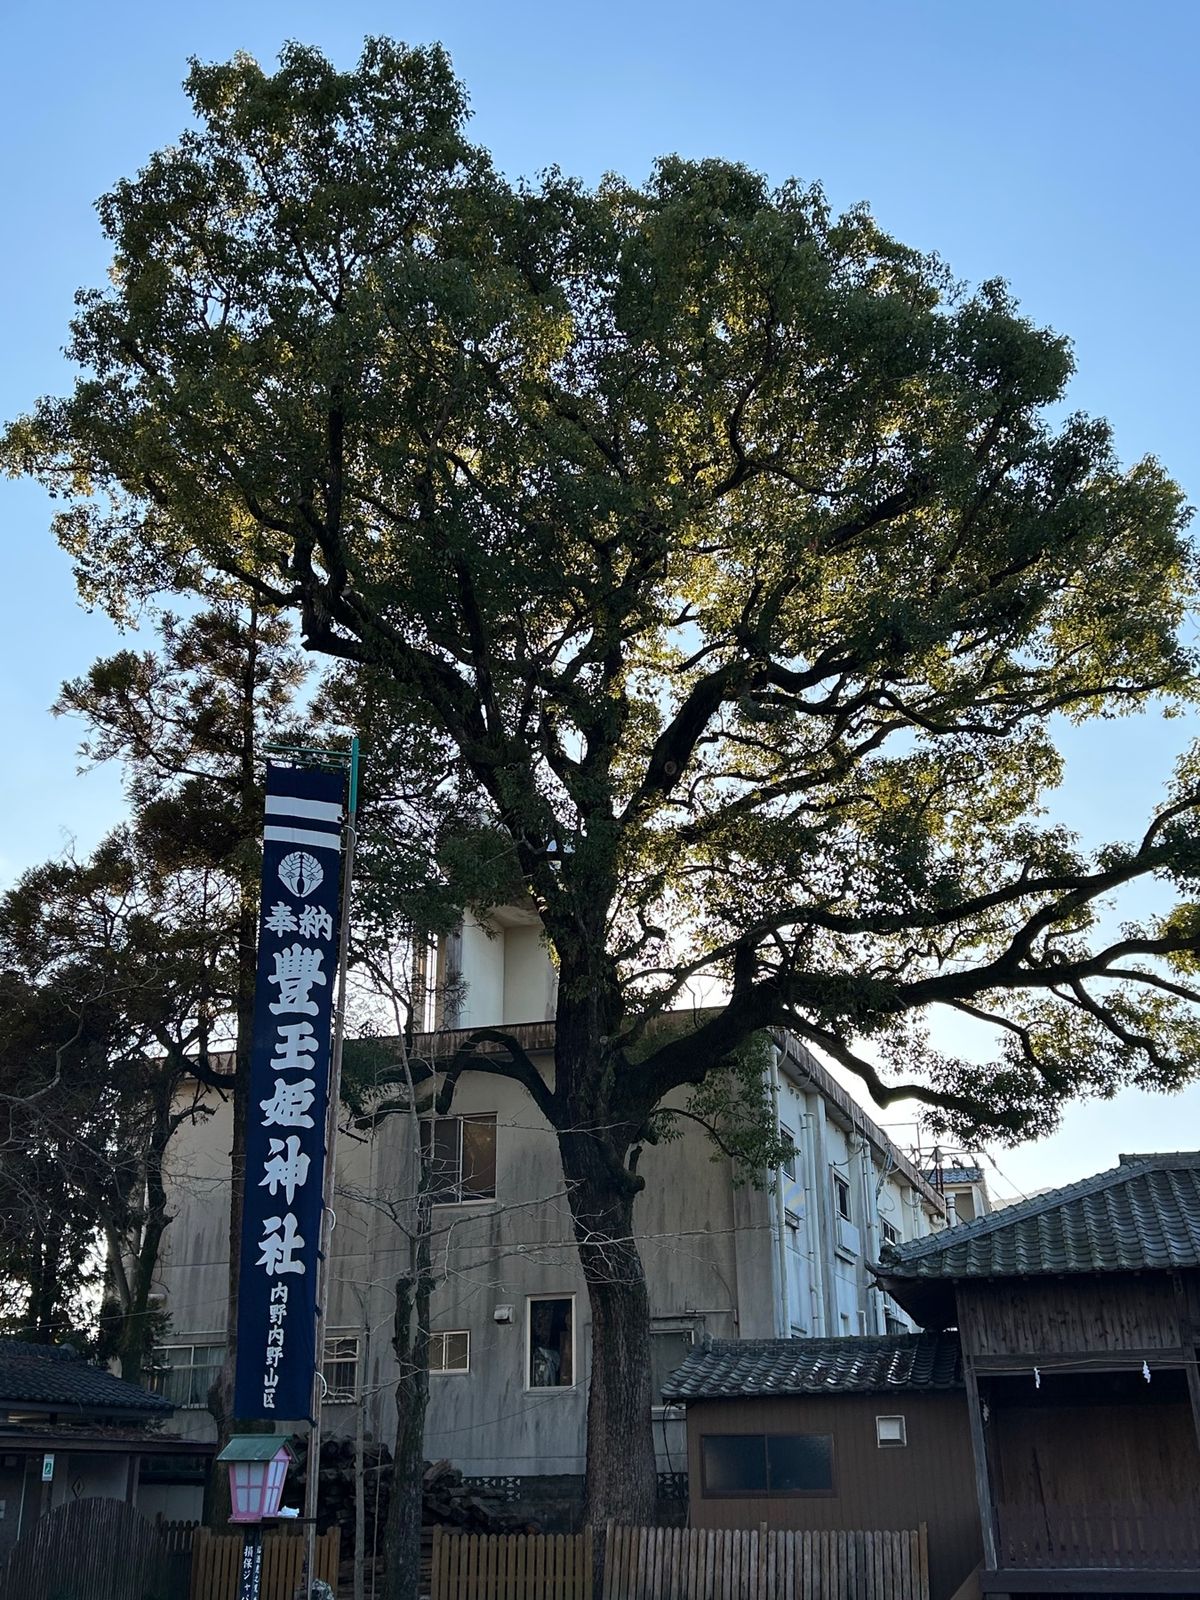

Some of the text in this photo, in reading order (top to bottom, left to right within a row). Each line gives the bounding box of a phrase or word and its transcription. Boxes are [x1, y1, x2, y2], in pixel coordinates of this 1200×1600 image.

[264, 901, 333, 941] 奉納
[263, 1281, 289, 1409] 内野内野山区
